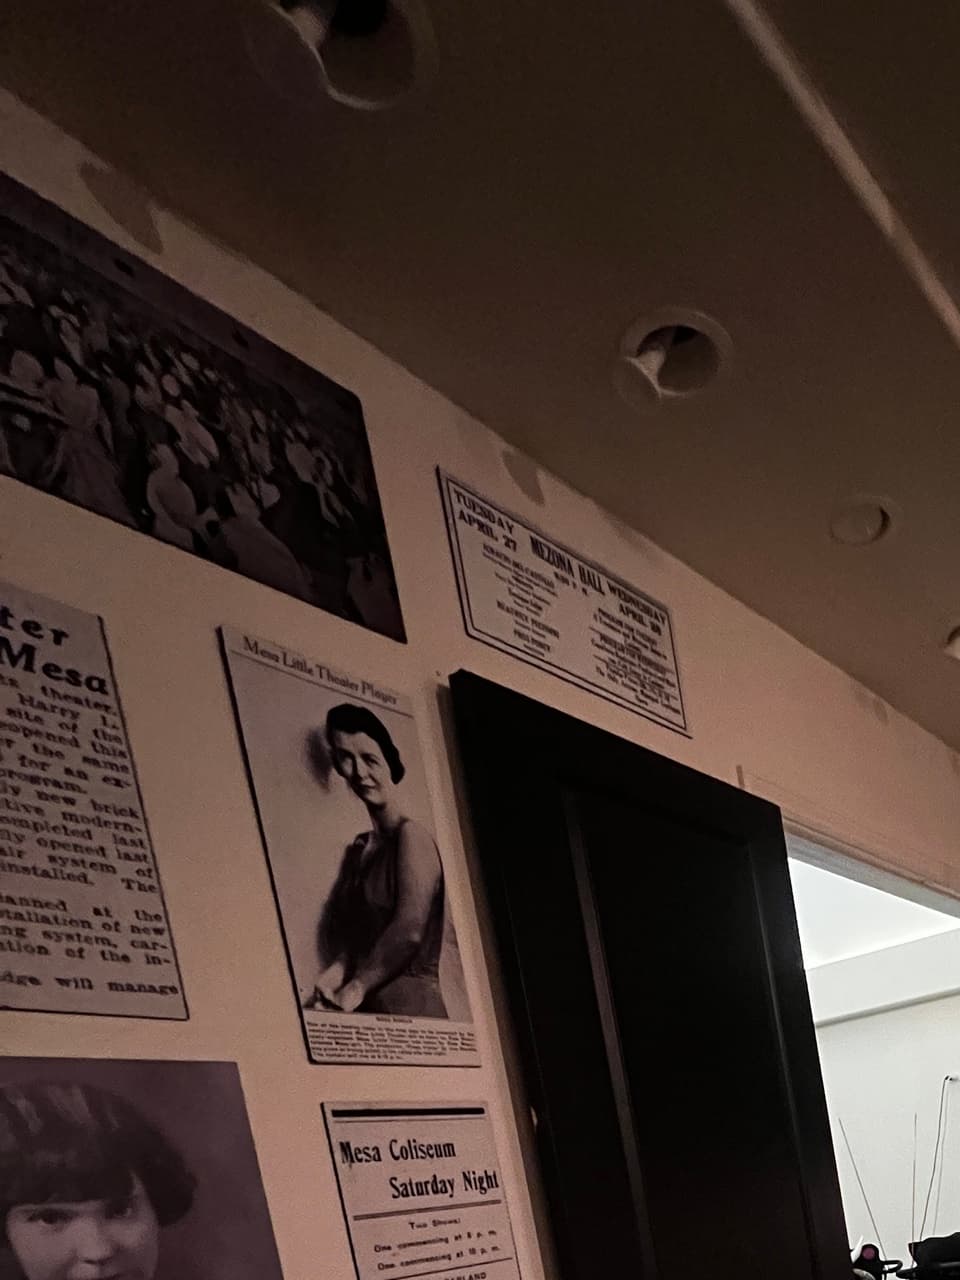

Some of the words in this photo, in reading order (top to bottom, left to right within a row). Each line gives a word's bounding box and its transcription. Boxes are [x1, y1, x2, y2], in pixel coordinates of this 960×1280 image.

[453, 488, 514, 534] TUESDAY
[459, 510, 498, 541] APRIL
[530, 535, 574, 578] MEZONA
[578, 564, 605, 595] HALL
[0, 606, 69, 645] ter
[0, 636, 109, 695] Mesa
[243, 635, 280, 664] Mesa
[283, 651, 315, 676] Little
[316, 663, 360, 692] Theater
[18, 693, 80, 719] Harry
[41, 686, 117, 716] theater.
[59, 722, 77, 733] of
[93, 729, 122, 745] the
[33, 743, 65, 760] the
[82, 756, 129, 774] same
[91, 741, 127, 759] this
[18, 754, 51, 772] for
[36, 790, 76, 806] new
[91, 799, 139, 819] brick
[61, 811, 142, 833] modern-
[36, 837, 107, 858] opened
[116, 848, 149, 863] last
[113, 833, 146, 850] last
[47, 854, 117, 875] system
[135, 867, 154, 879] of
[121, 877, 157, 893] The
[93, 906, 113, 918] at
[134, 909, 162, 923] the
[101, 919, 121, 933] of
[130, 924, 165, 936] new
[65, 947, 85, 960] of
[100, 949, 131, 963] the
[145, 953, 171, 965] in-
[130, 938, 168, 950] car-
[55, 976, 93, 990] will
[107, 980, 178, 995] manage
[339, 1141, 382, 1165] Mesa
[389, 1139, 456, 1162] Coliseum
[389, 1174, 456, 1199] Saturday
[462, 1170, 499, 1195] Night
[374, 1244, 392, 1253] One
[378, 1261, 396, 1271] One
